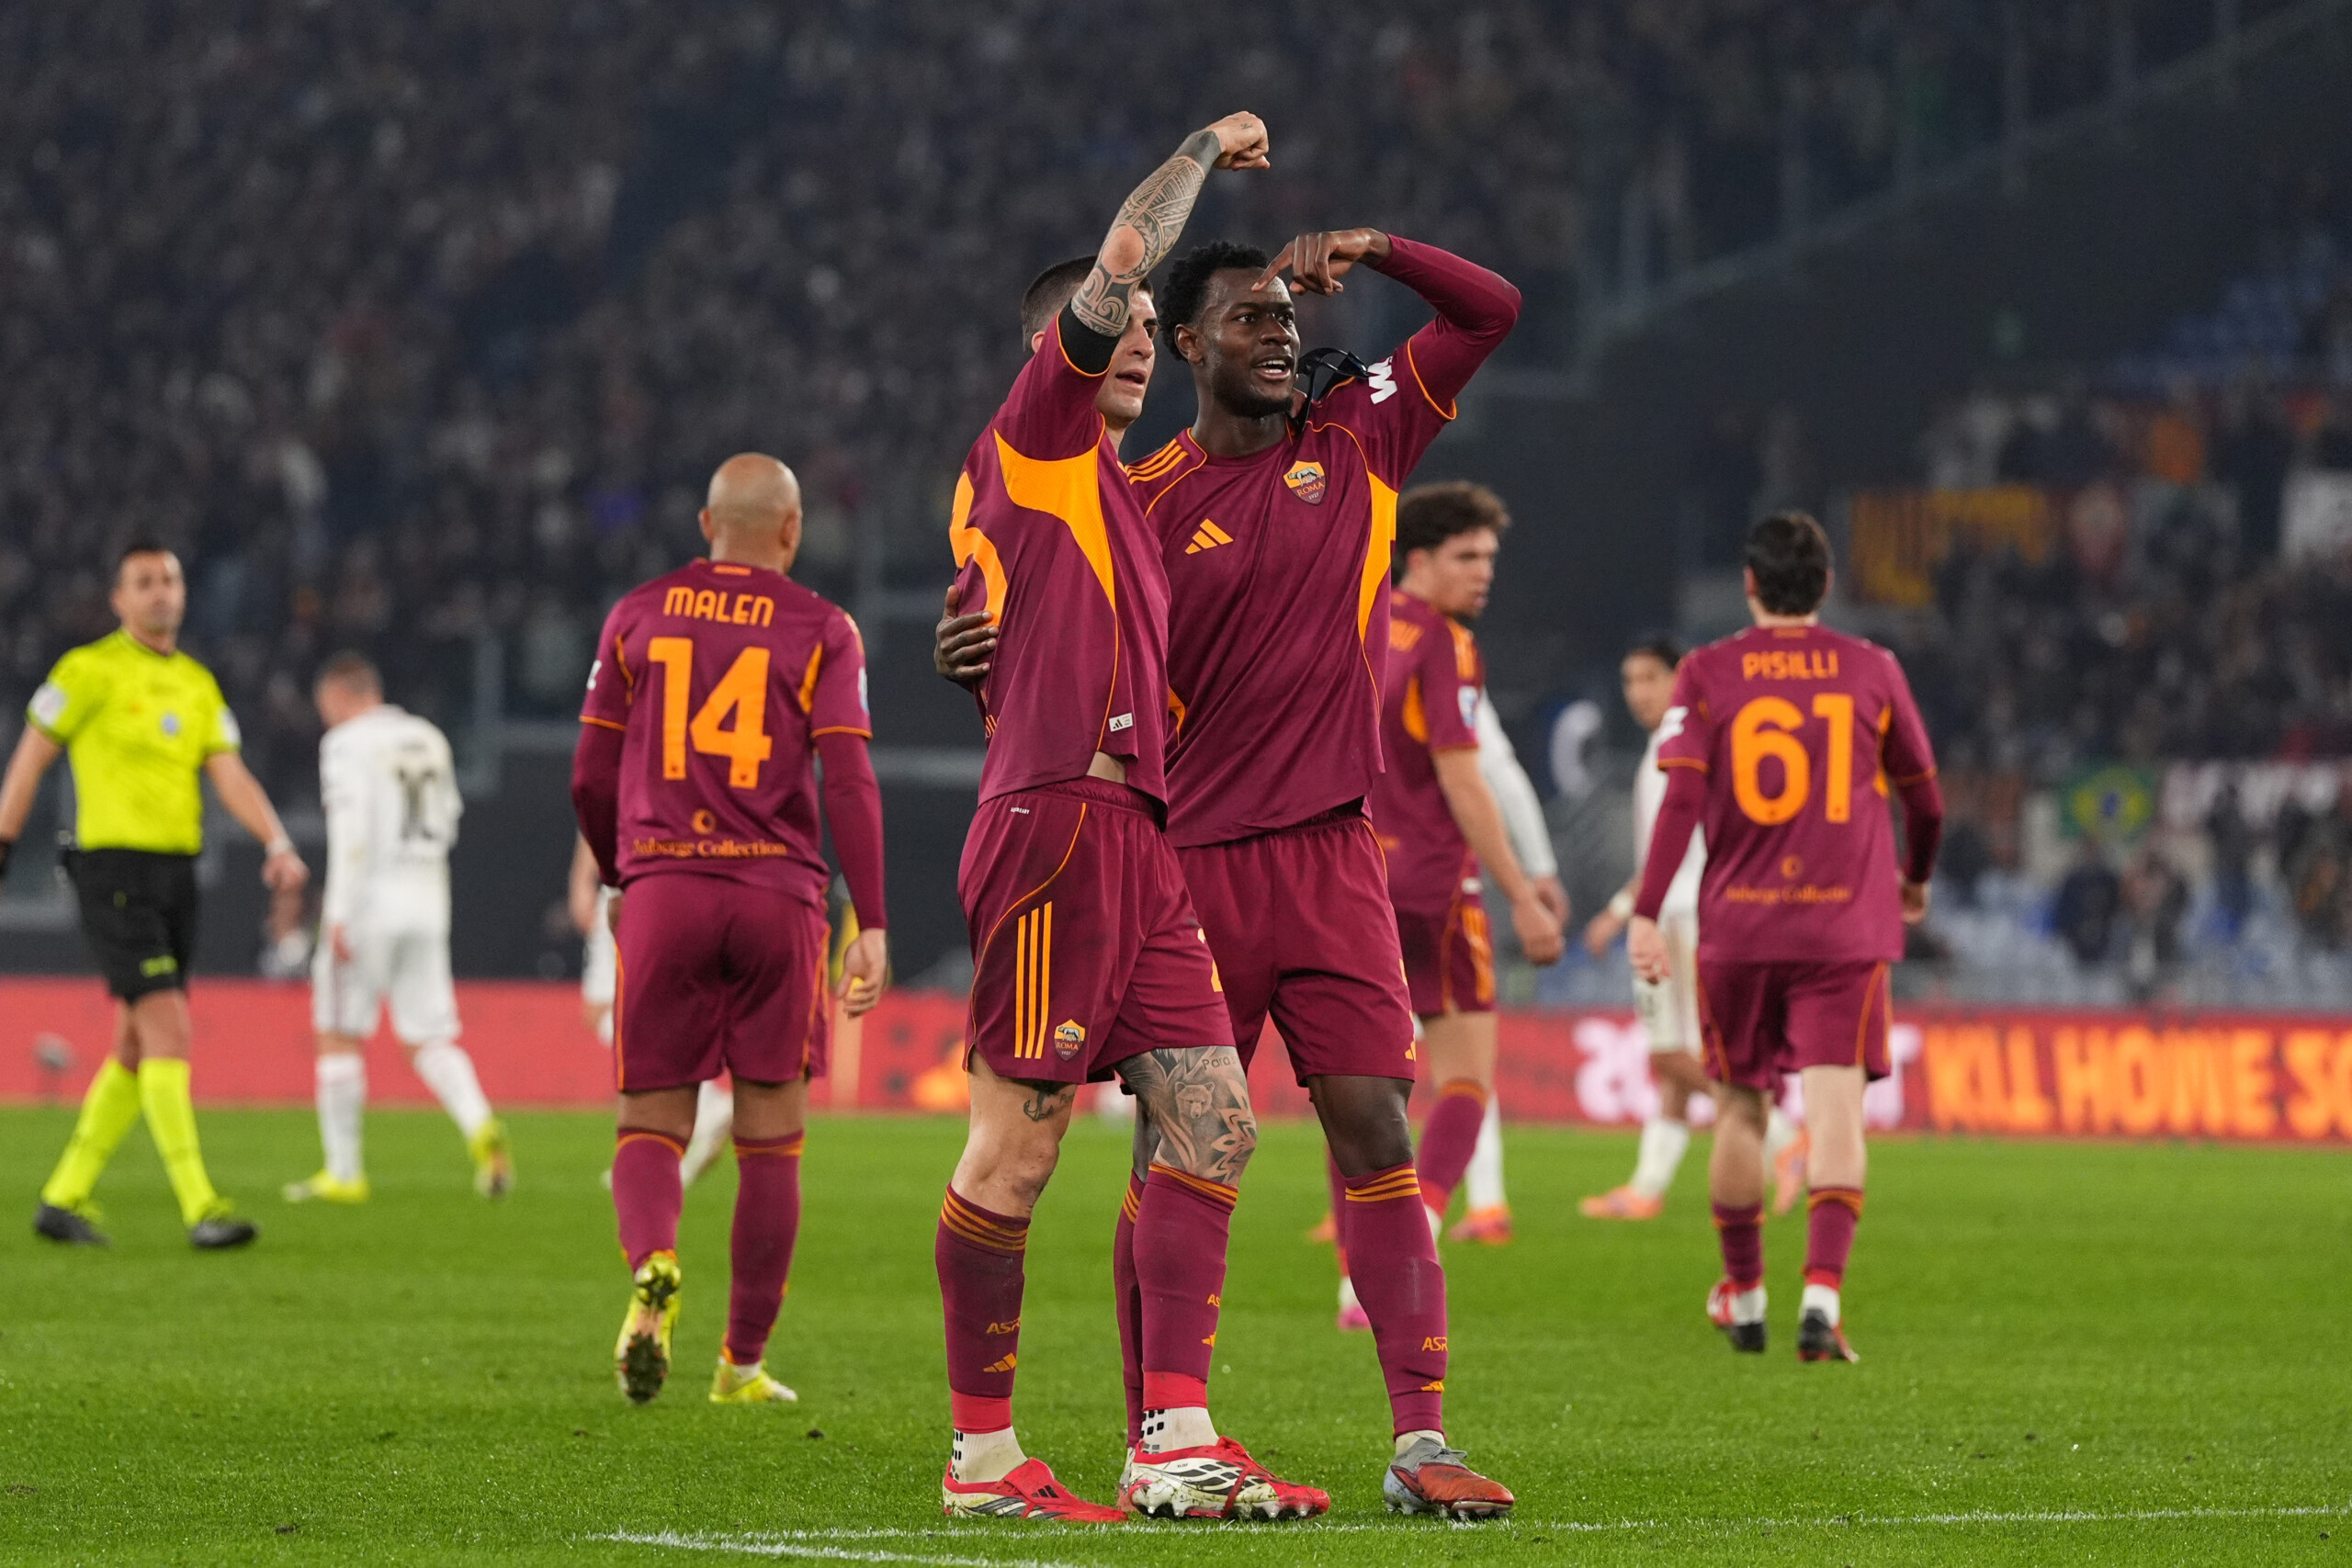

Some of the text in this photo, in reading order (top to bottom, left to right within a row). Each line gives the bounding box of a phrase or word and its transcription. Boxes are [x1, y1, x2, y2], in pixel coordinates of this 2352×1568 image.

[1296, 481, 1326, 497] ROMA
[663, 586, 775, 628] MALEN
[1742, 649, 1839, 682] PISILLI
[647, 636, 772, 789] 14
[1730, 693, 1855, 826] 61
[1056, 1042, 1080, 1051] ROMA
